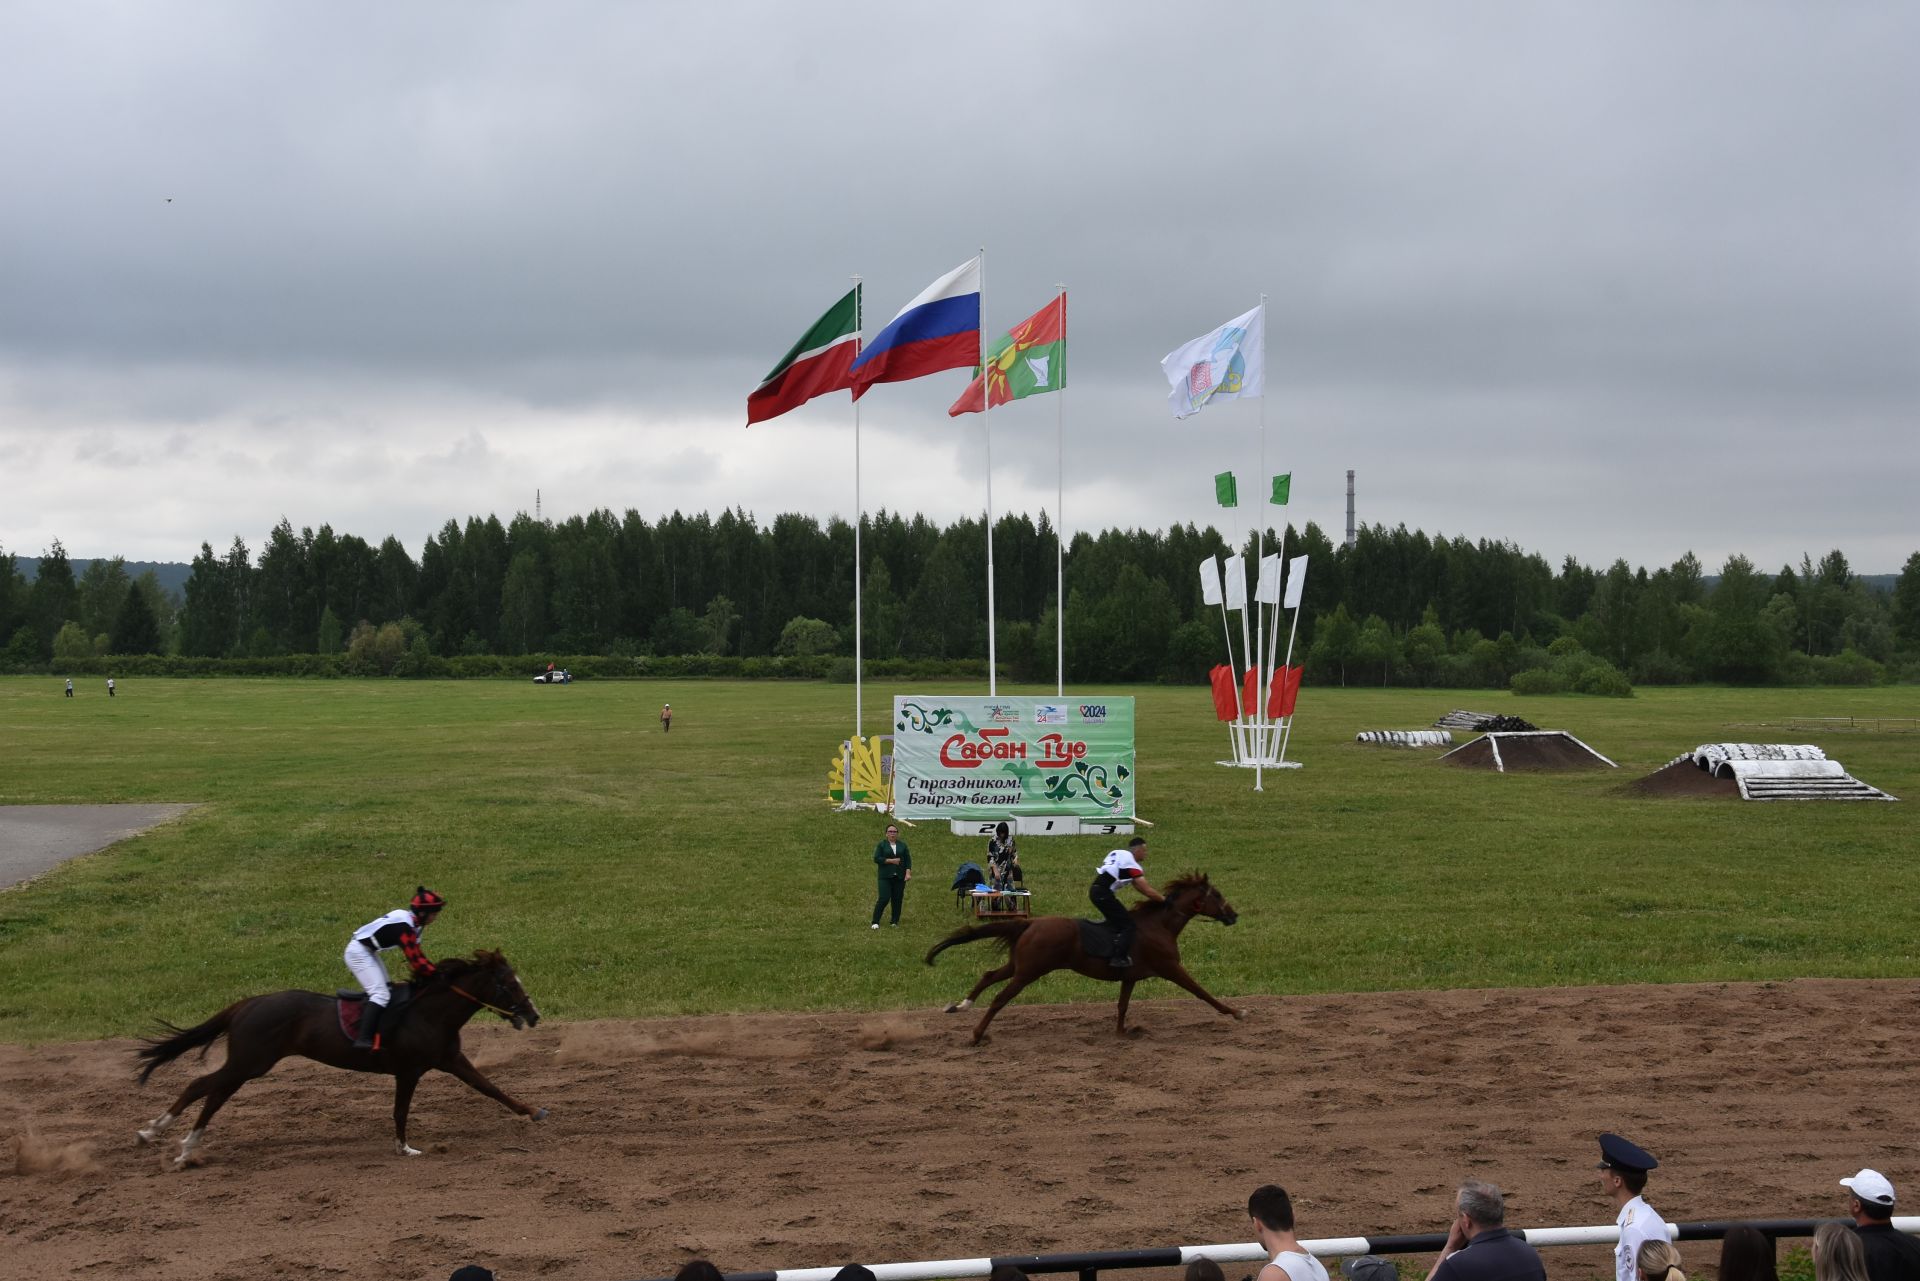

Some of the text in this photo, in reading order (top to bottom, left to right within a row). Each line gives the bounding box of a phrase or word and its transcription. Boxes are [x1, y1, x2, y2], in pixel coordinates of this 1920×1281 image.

[1084, 705, 1106, 718] 2024
[939, 726, 1027, 768] Сабан
[908, 776, 1022, 792] С праздником!
[907, 792, 1021, 808] Бәйрәм белән!
[979, 824, 996, 833] 2
[1045, 821, 1054, 831] 1
[1101, 825, 1116, 835] 3
